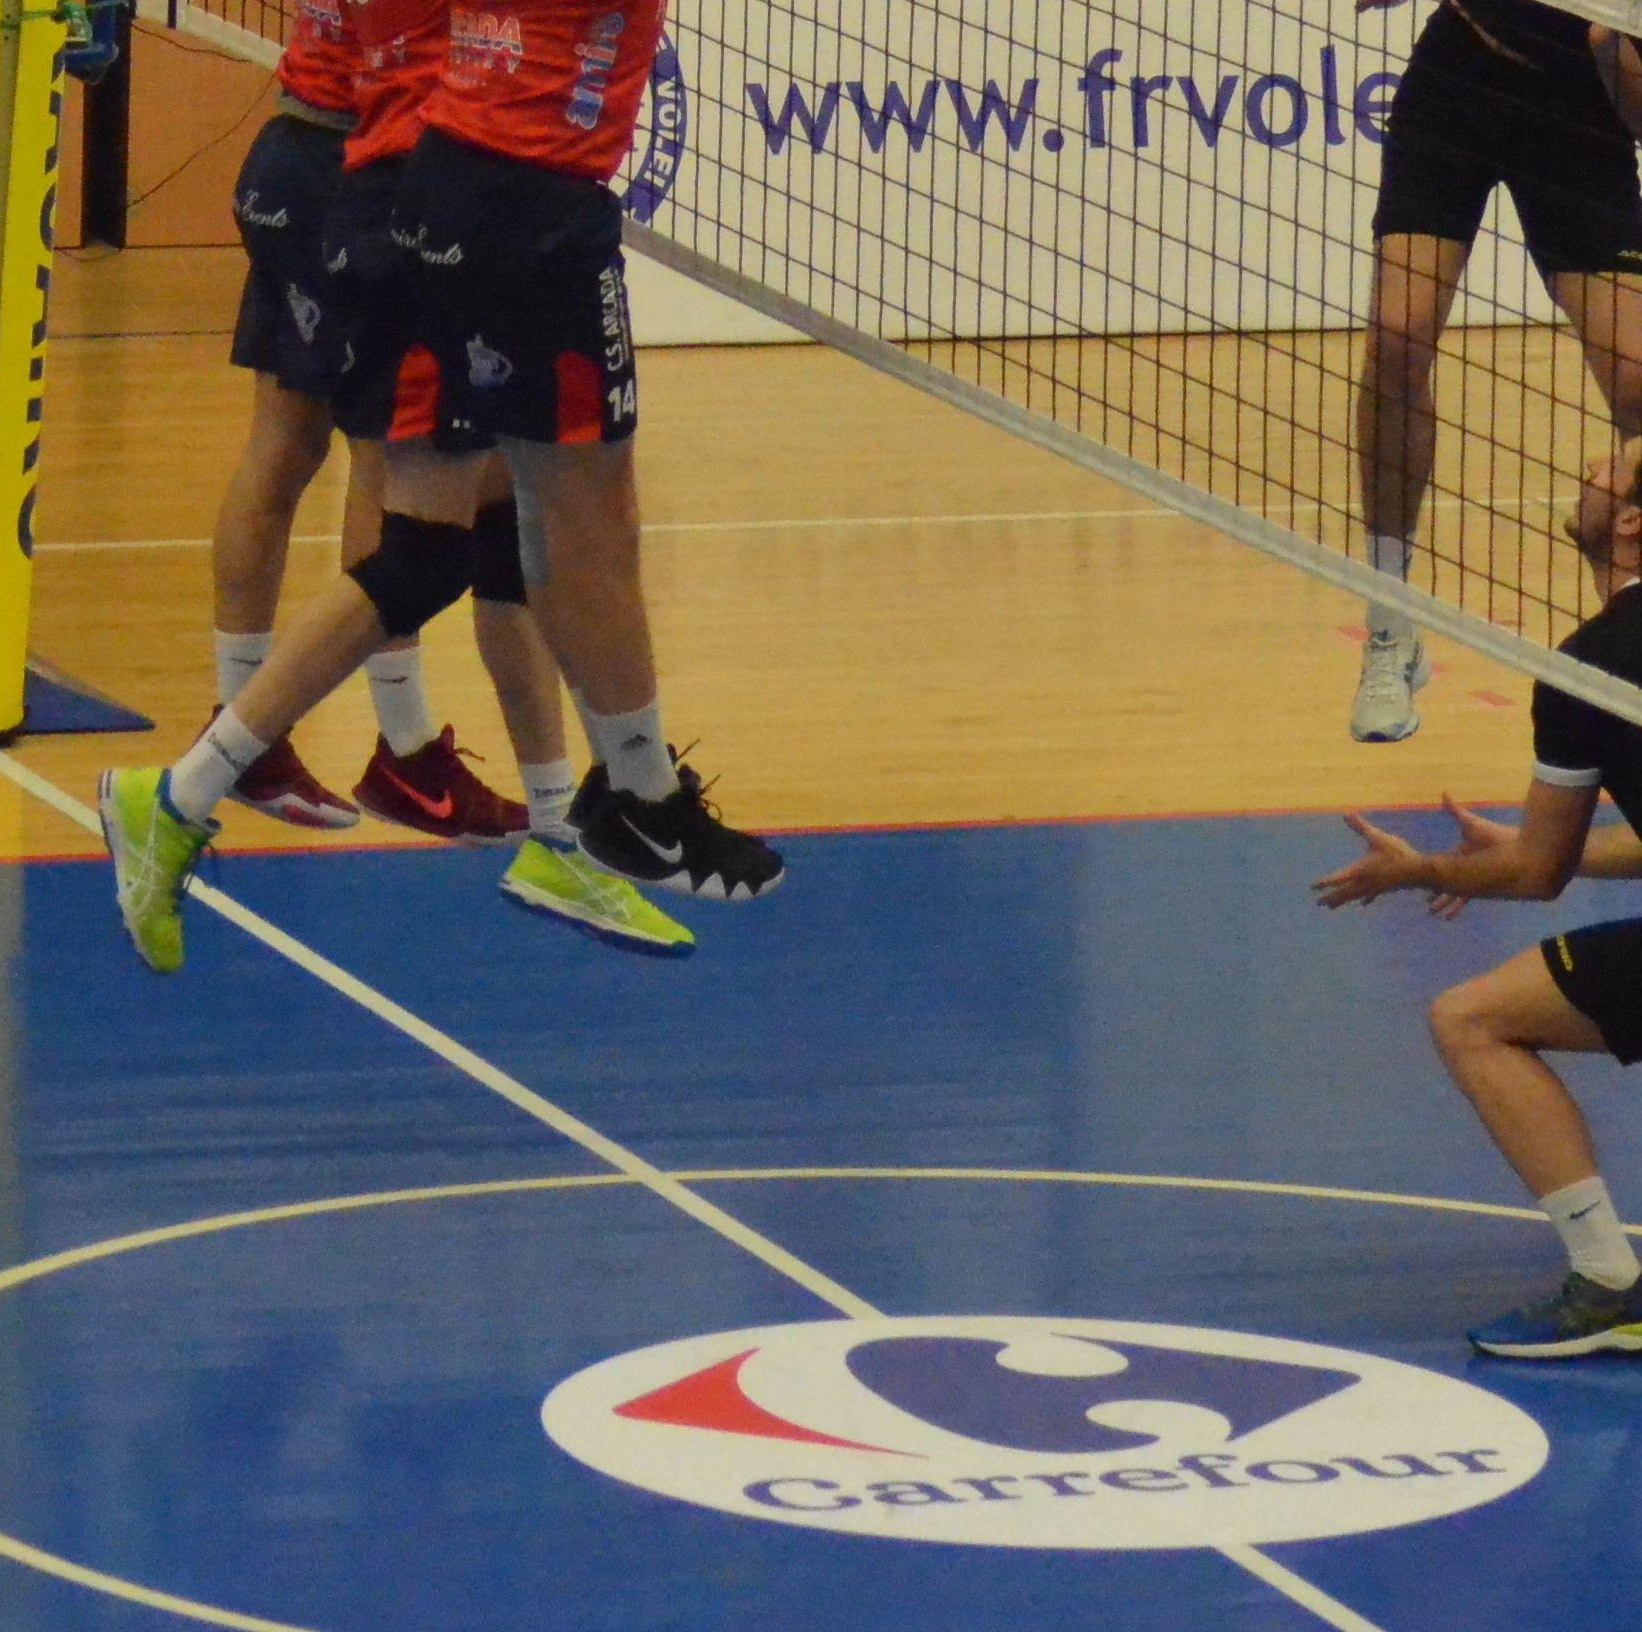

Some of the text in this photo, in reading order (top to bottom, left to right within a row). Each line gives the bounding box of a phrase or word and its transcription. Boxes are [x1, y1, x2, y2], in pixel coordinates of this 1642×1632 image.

[642, 75, 682, 189] VOLEI
[607, 378, 636, 422] 14
[741, 1443, 1508, 1518] Carrefour
